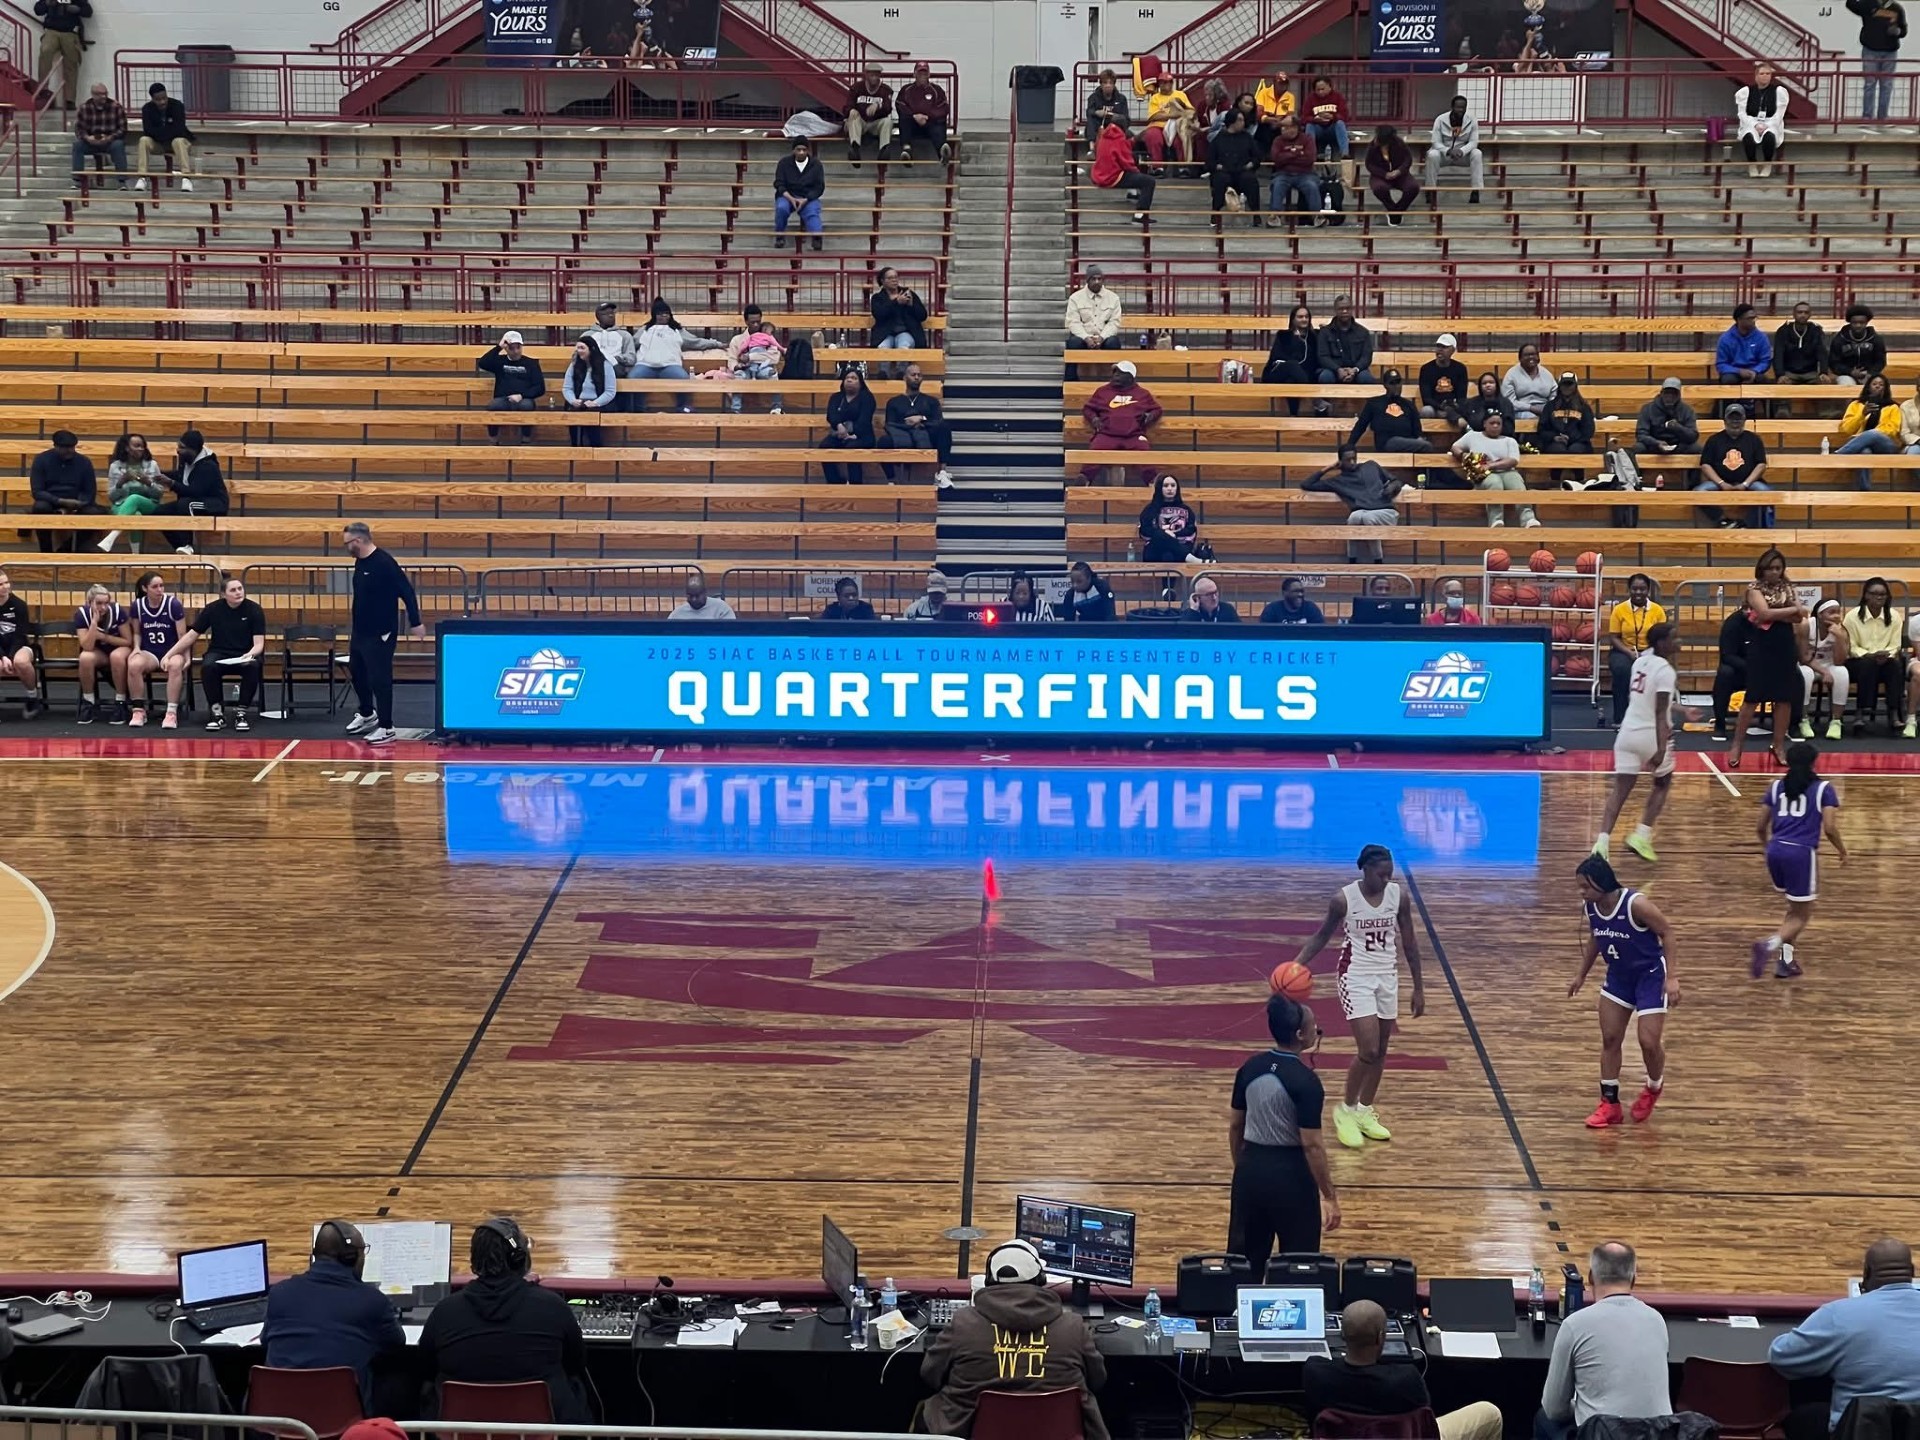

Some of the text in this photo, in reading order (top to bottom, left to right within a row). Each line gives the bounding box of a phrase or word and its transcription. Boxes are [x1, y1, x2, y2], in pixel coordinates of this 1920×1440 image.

[323, 2, 340, 11] GG
[511, 6, 548, 14] MAKE IT
[884, 8, 899, 18] HH
[1395, 4, 1430, 12] DIVISION
[1819, 7, 1832, 16] JJ
[1138, 9, 1154, 18] HH
[1400, 15, 1437, 23] MAKE IT
[489, 9, 548, 36] YOURS
[1378, 17, 1436, 46] YOURS
[148, 632, 165, 644] 23
[648, 648, 1338, 666] 2025 SIAC BASKETBALL TOURNAMENT PRESENTED BY CRICKET
[500, 672, 580, 695] SIAC
[1405, 676, 1487, 698] SIAC
[668, 671, 1317, 724] QUARTERFINALS
[320, 771, 392, 785] Jr.
[404, 771, 648, 787] McAfee
[1777, 792, 1808, 817] 10
[1355, 917, 1394, 929] TUSKEGEE
[1593, 928, 1630, 939] Badgers
[1365, 931, 1387, 952] 24
[1607, 944, 1620, 959] 4
[1260, 1310, 1299, 1322] SIAC
